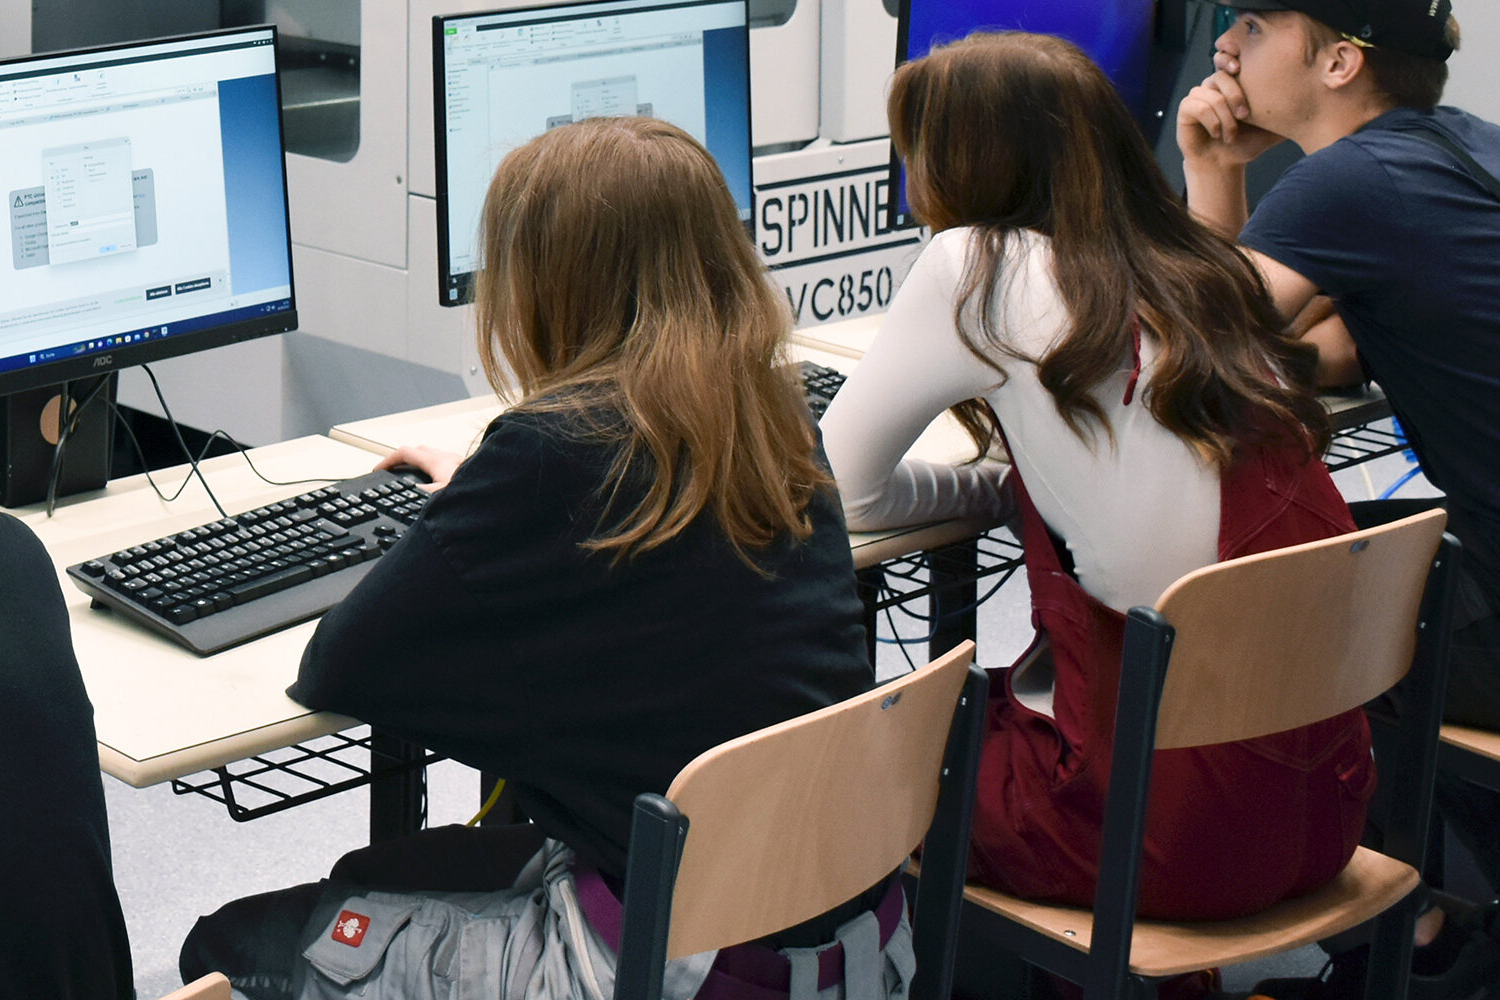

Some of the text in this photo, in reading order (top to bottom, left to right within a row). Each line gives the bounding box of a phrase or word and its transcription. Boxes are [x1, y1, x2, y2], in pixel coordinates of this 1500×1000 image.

[762, 179, 891, 257] SPINNE
[786, 266, 893, 322] VC850
[93, 355, 113, 368] AOC
